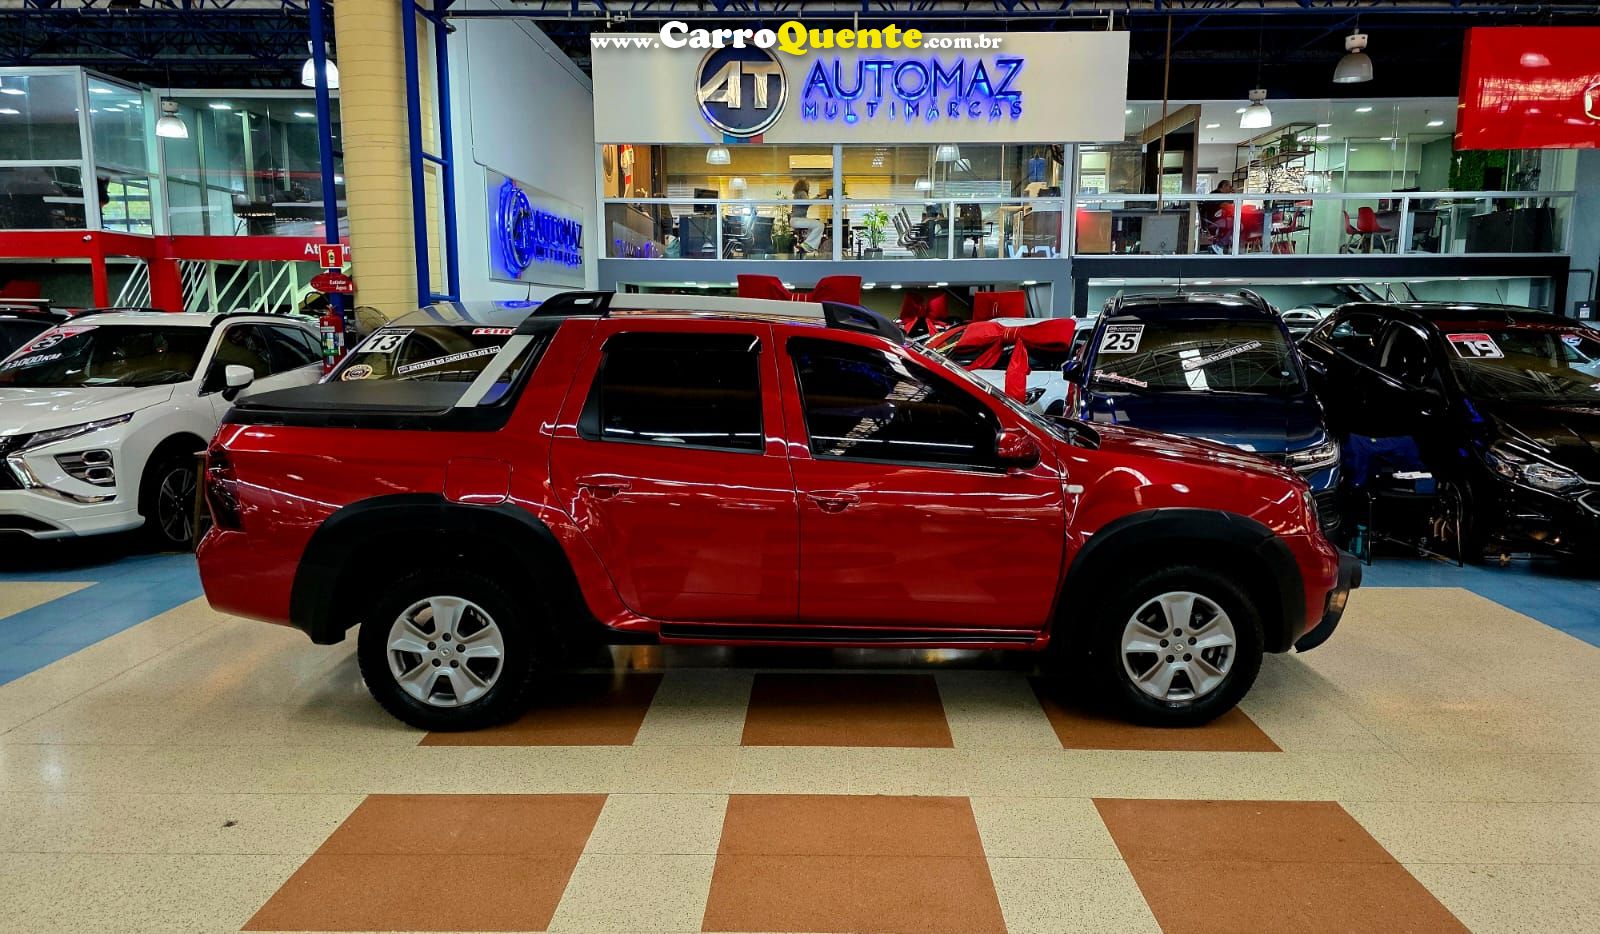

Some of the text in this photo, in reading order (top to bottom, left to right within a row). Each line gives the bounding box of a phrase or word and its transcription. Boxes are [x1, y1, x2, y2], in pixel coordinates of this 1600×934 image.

[804, 58, 1024, 99] AUTOMAZ
[803, 100, 1023, 121] MULTIMARCAS
[369, 335, 402, 350] 13
[1103, 334, 1137, 350] 25
[1463, 340, 1501, 357] 19
